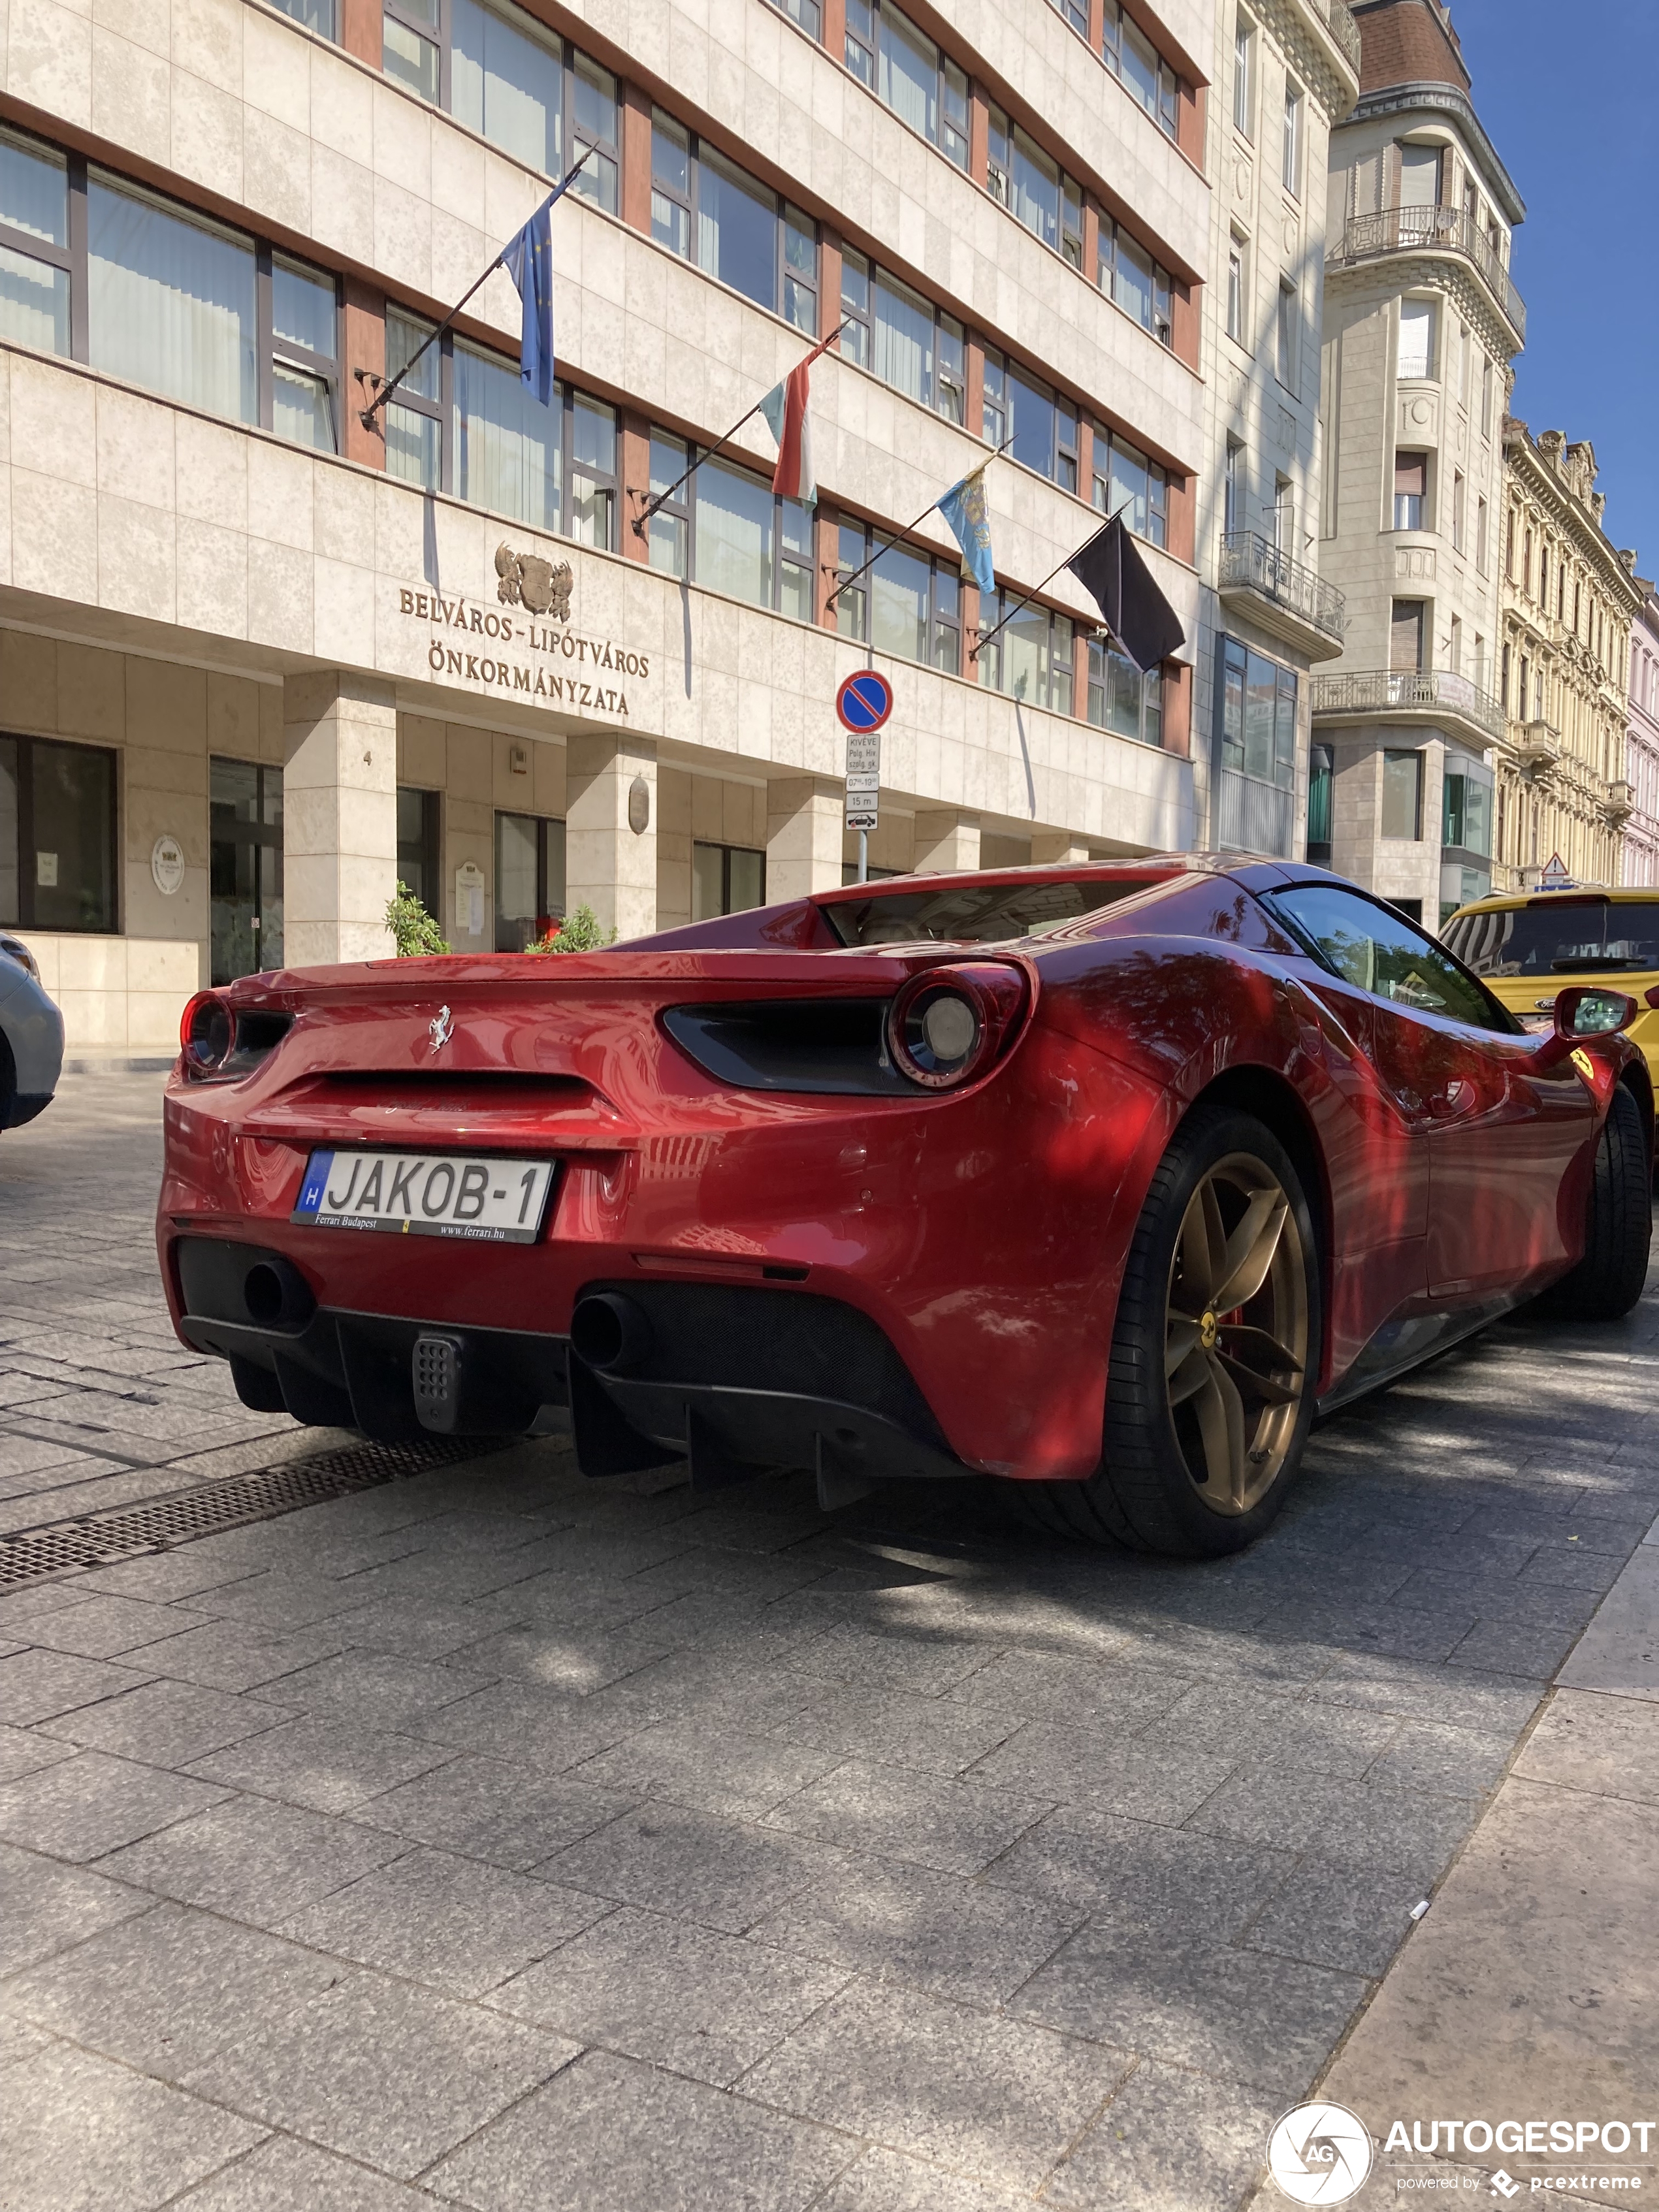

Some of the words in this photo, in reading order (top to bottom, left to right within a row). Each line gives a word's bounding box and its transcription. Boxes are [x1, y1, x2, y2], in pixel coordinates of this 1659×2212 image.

[428, 639, 629, 714] ÖNKORMÁNYZATA
[850, 736, 877, 746] KIVÉVE
[363, 750, 372, 766] 4
[853, 797, 861, 805] 15
[306, 1187, 319, 1206] H
[329, 1159, 537, 1224] JAKOB-1
[315, 1214, 340, 1225] Ferrari
[342, 1216, 377, 1229] Budapest
[441, 1225, 505, 1240] www.ferrari.hu
